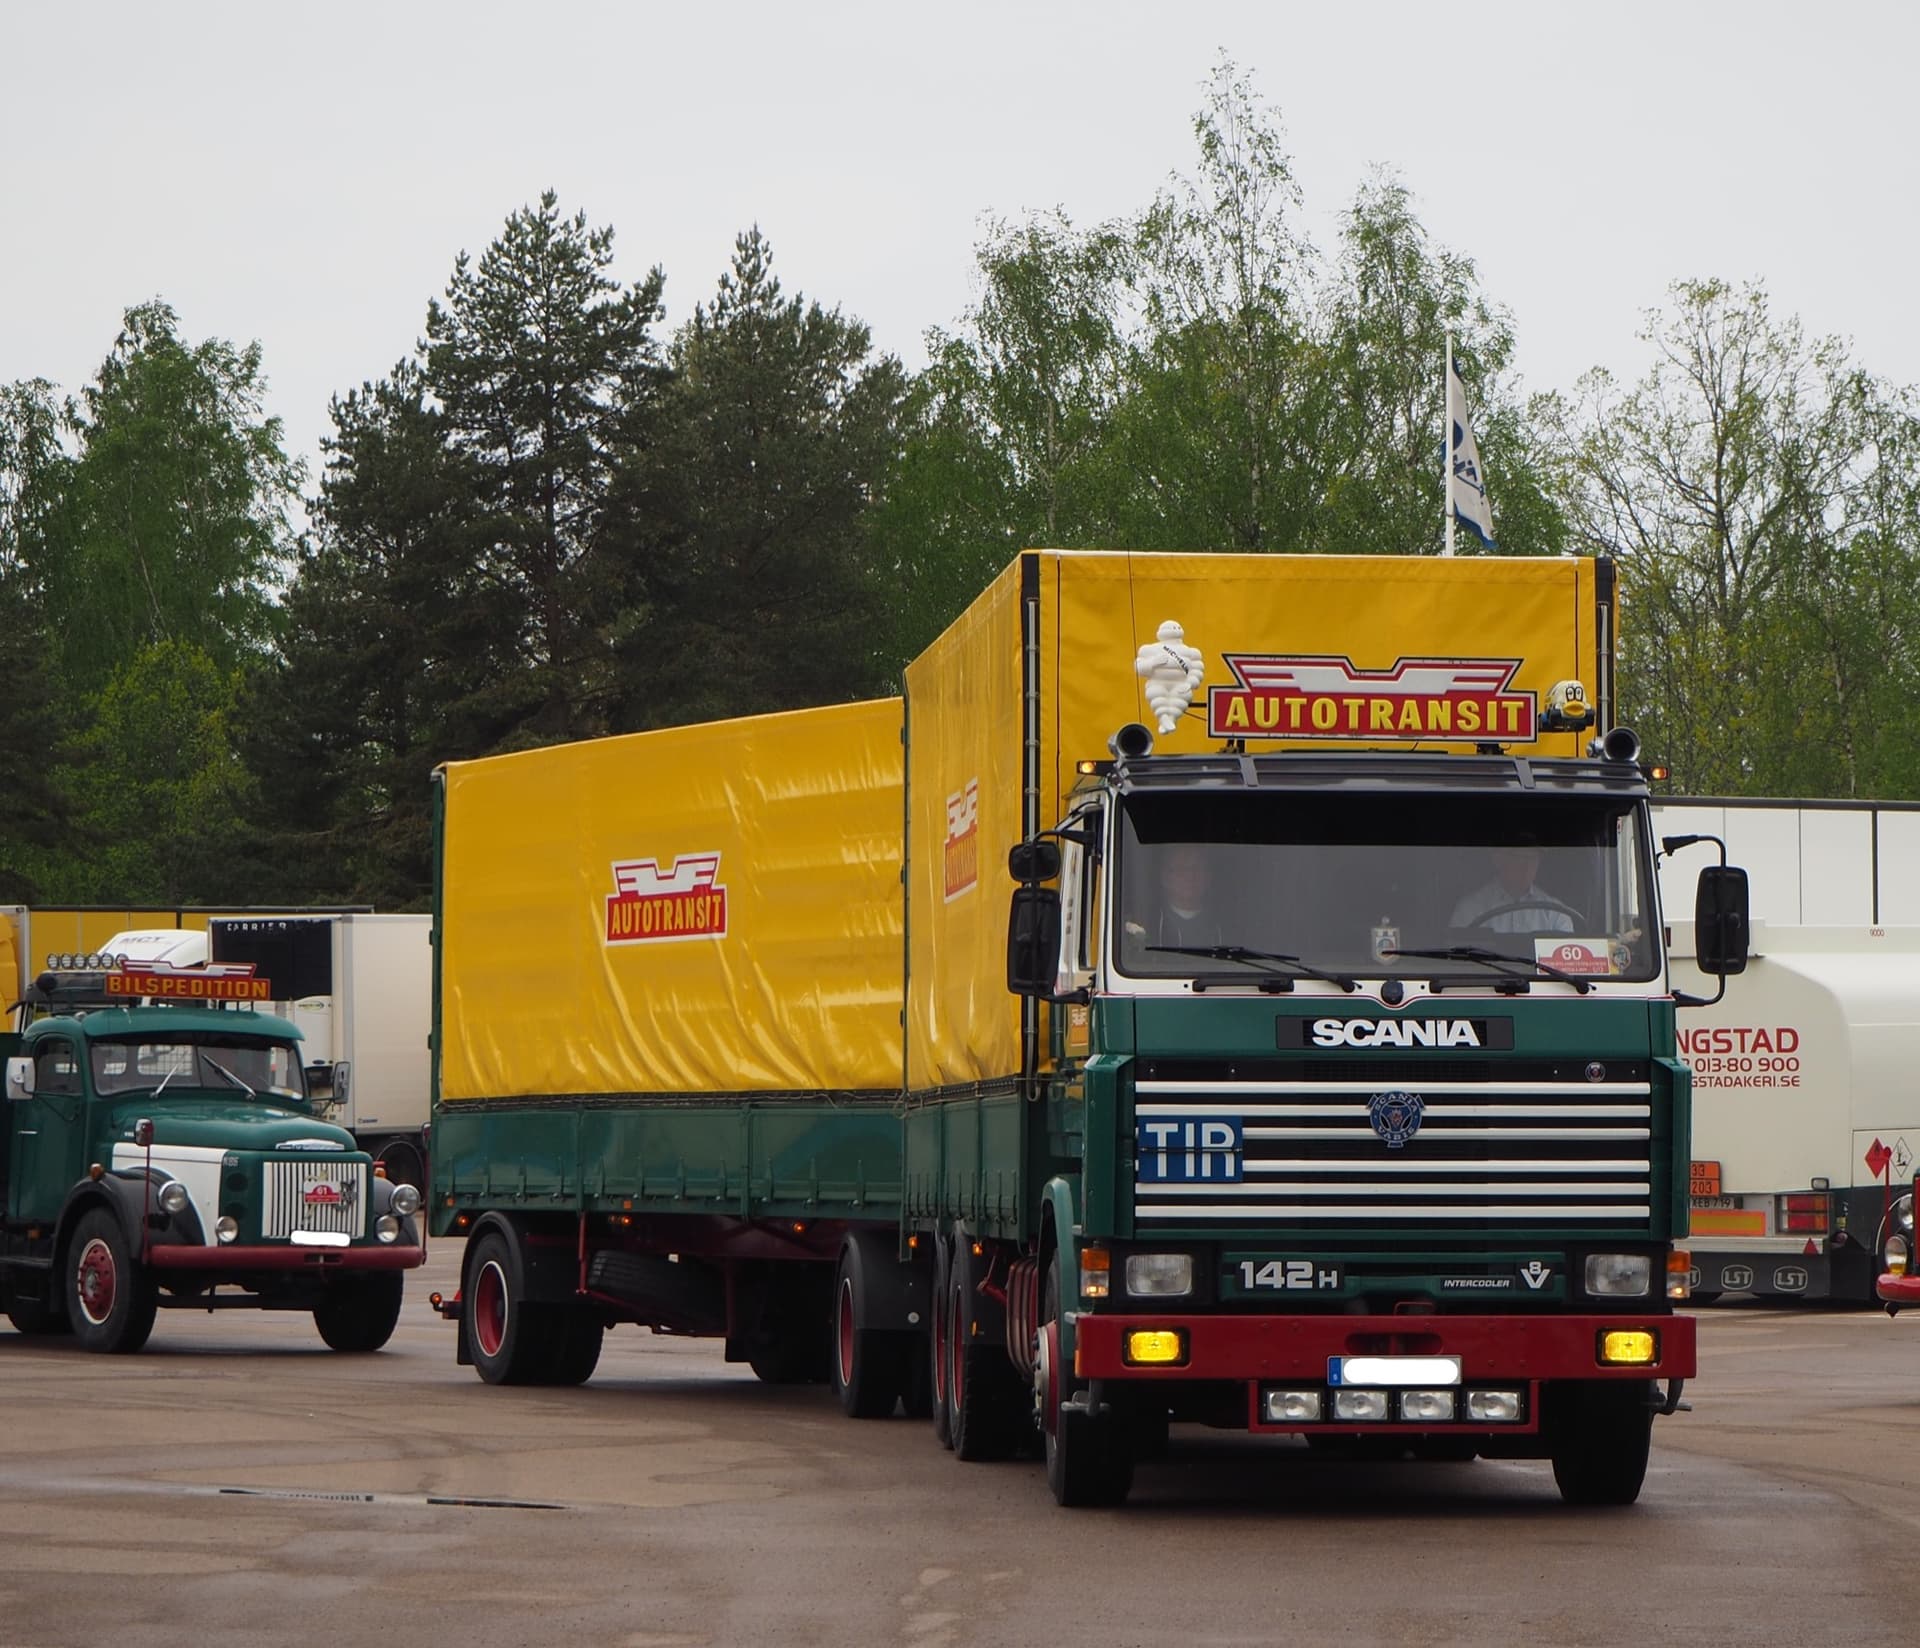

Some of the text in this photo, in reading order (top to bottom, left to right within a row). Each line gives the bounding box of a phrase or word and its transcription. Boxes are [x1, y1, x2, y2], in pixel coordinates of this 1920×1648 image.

[1225, 696, 1524, 732] AUTOTRANSIT
[611, 894, 722, 935] AUTOTRANSIT
[227, 922, 287, 932] CARRIER
[1561, 946, 1582, 961] 60
[109, 976, 267, 998] BILSPEDITION
[1312, 1019, 1480, 1047] SCANIA
[1695, 1057, 1753, 1073] 013-80
[1758, 1057, 1800, 1072] 900
[1375, 1094, 1418, 1112] SCANIA
[1378, 1125, 1415, 1140] VABIS
[1145, 1122, 1235, 1177] TIR
[1239, 1261, 1338, 1289] 142 H
[1443, 1278, 1511, 1288] INTERCOOLER
